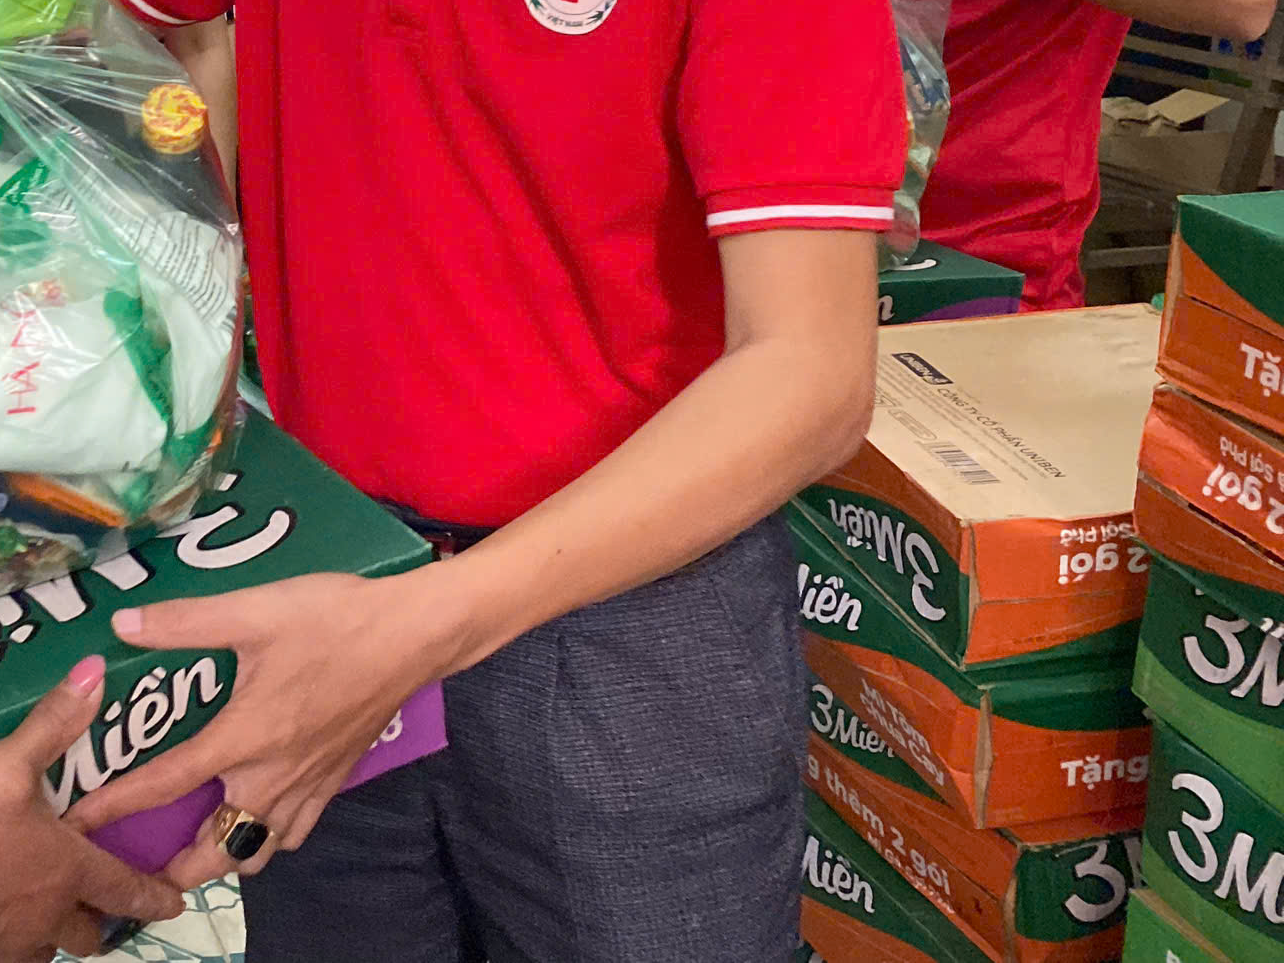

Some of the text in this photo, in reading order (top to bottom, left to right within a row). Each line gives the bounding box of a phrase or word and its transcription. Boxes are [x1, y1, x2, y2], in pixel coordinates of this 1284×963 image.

[1240, 341, 1284, 397] Tặ
[1019, 447, 1066, 478] UNIBEN
[1202, 463, 1263, 512] gói
[1057, 542, 1149, 586] 2 gói
[1060, 754, 1149, 790] Tặng
